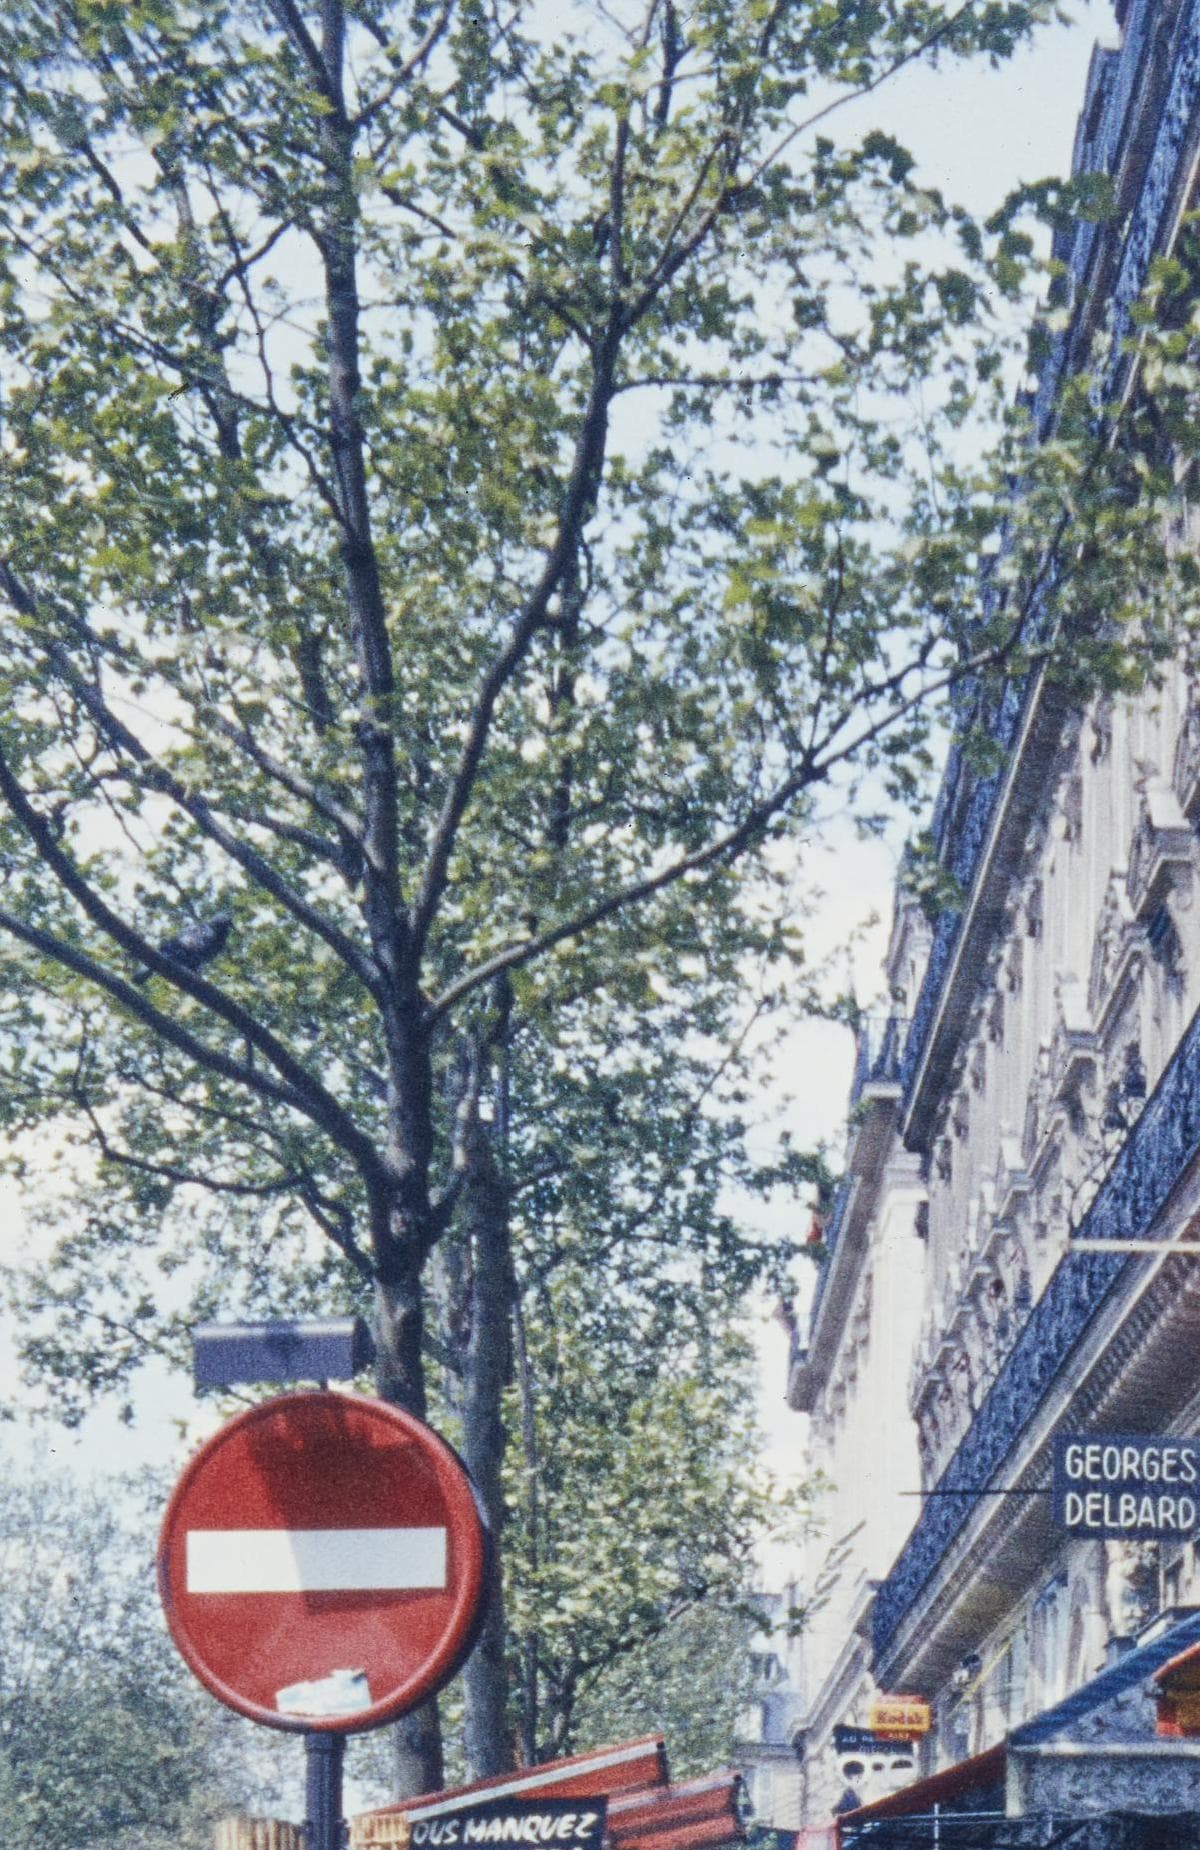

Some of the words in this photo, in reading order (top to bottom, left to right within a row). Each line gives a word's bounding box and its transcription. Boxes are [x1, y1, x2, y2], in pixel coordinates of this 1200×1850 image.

[1065, 1445, 1198, 1482] GEORGES
[1065, 1492, 1196, 1530] DELBARD
[876, 1708, 923, 1725] Kodak
[412, 1819, 461, 1846] OUS
[465, 1812, 598, 1845] MANQUEZ
